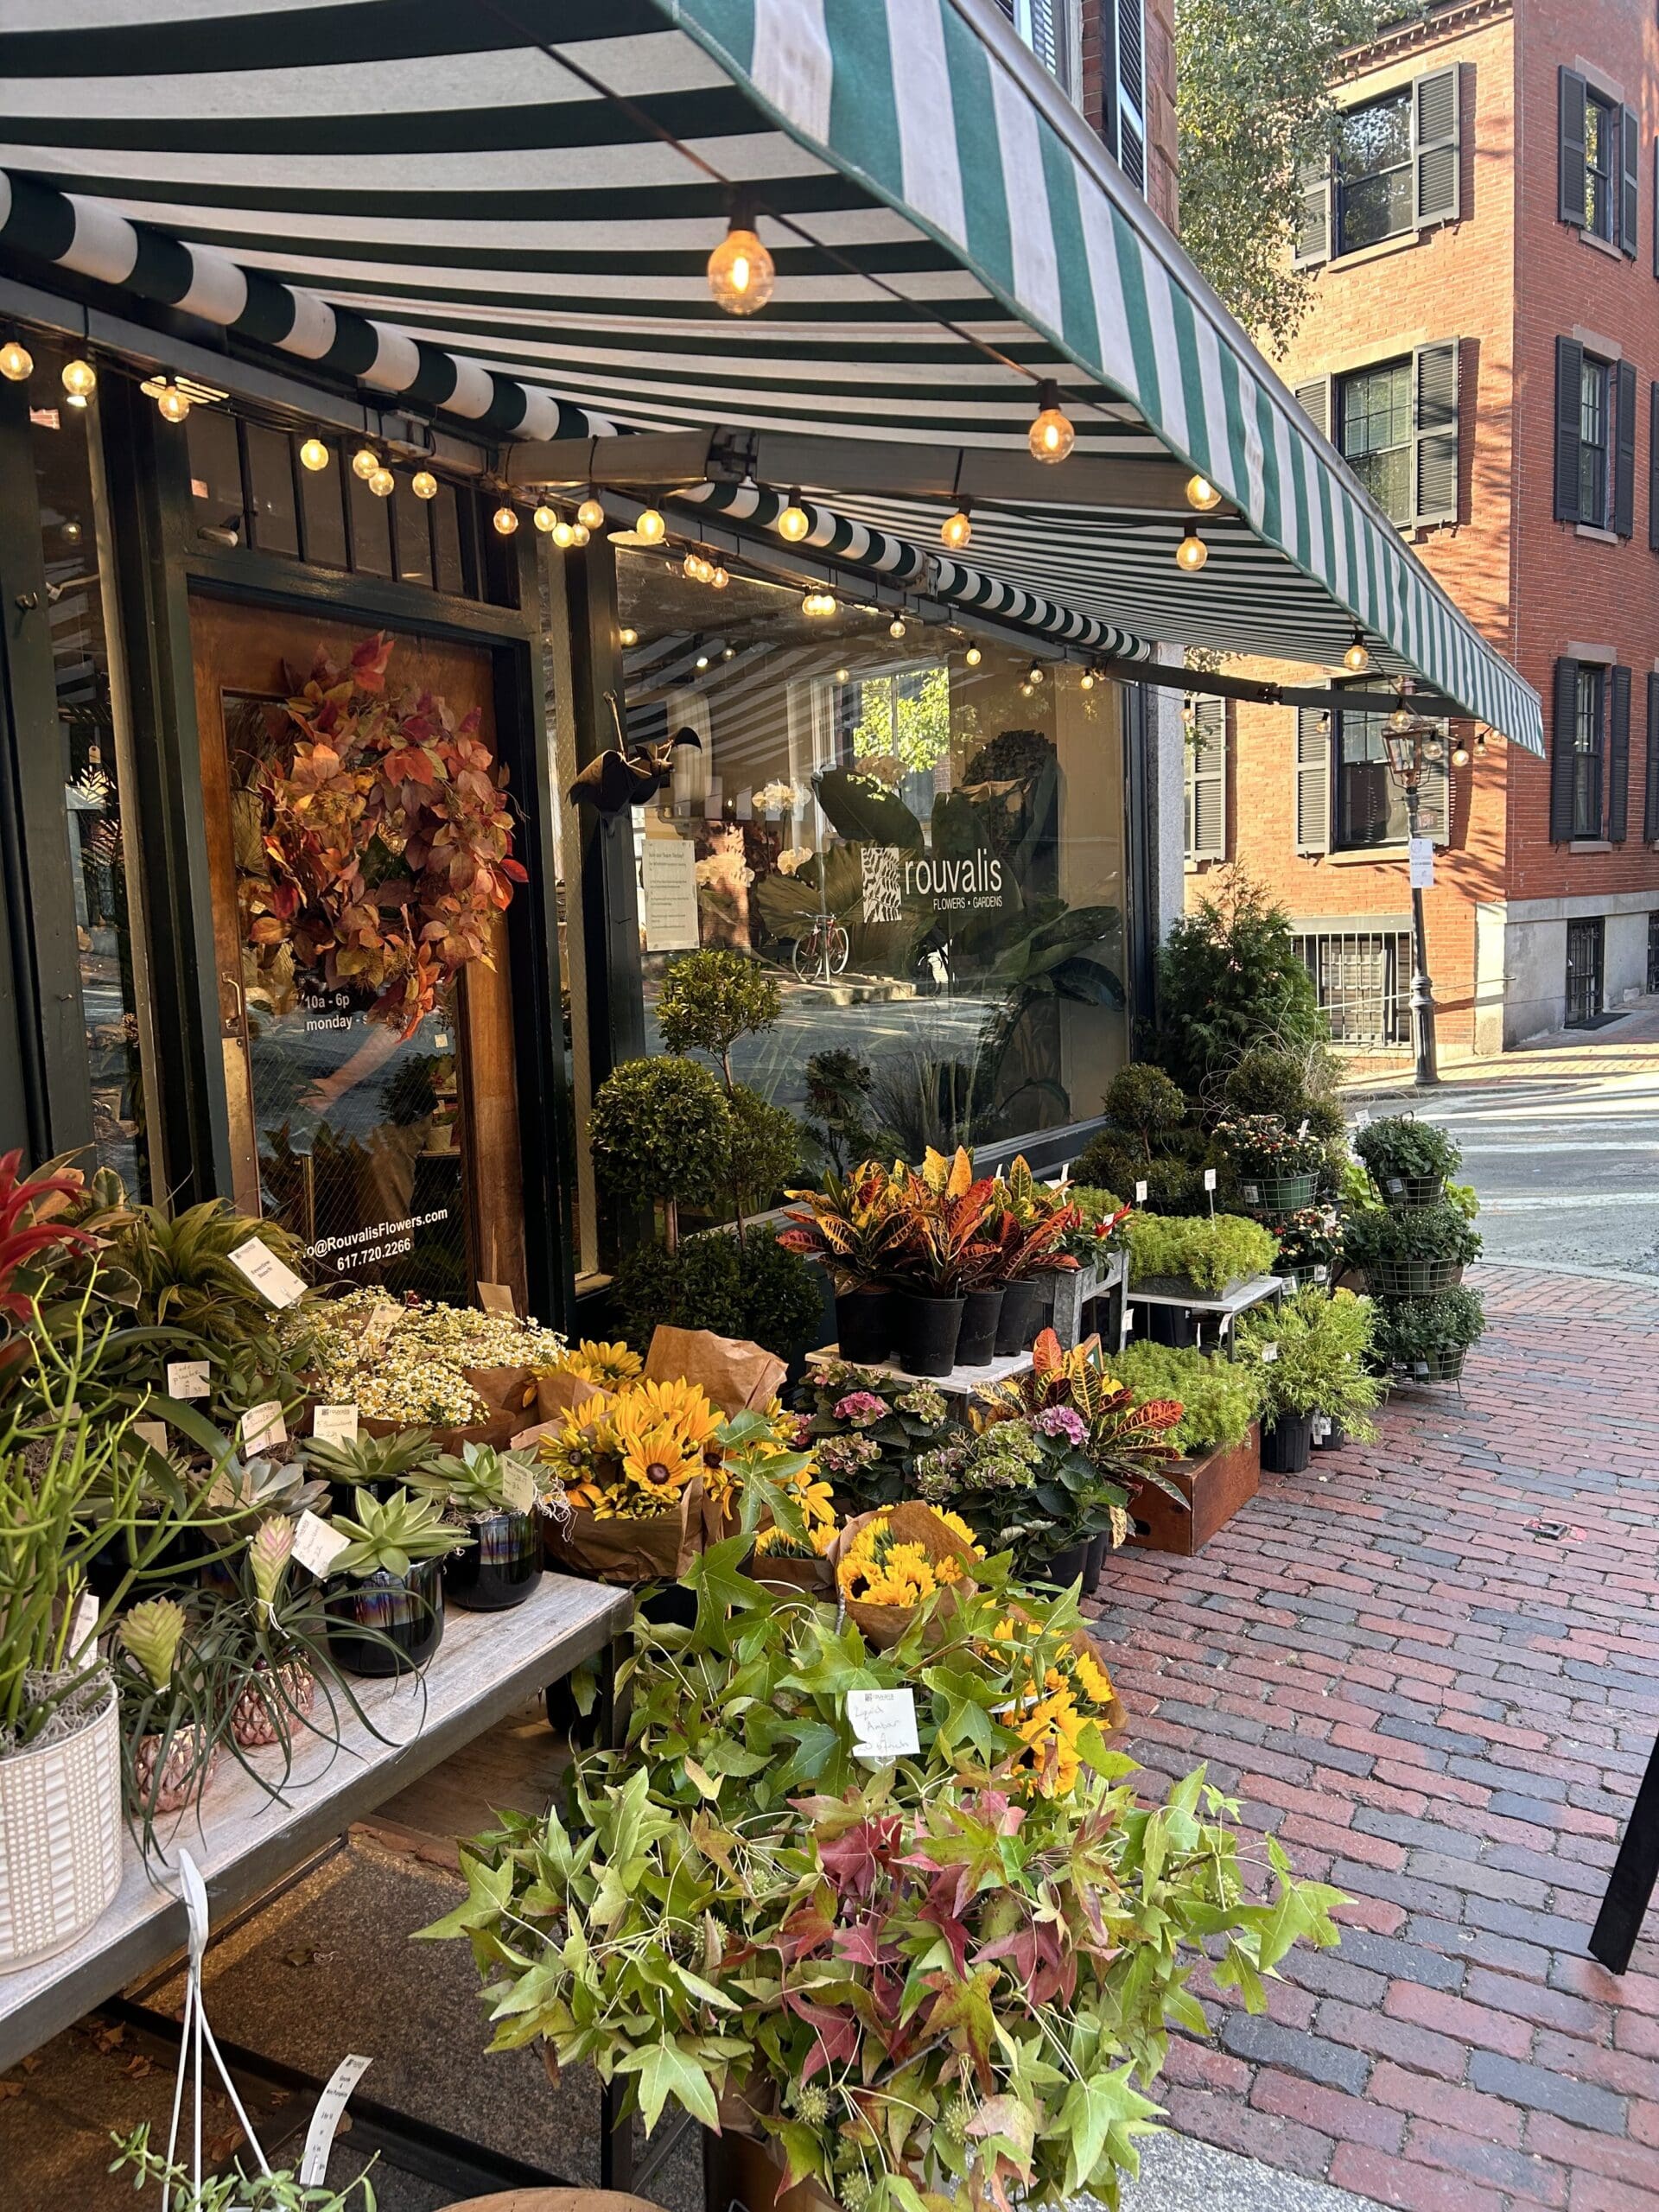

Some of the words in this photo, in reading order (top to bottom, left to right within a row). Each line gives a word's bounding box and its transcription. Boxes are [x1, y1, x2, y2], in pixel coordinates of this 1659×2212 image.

[905, 848, 1002, 895] rouvalis
[933, 897, 966, 911] FLOWERS
[972, 895, 1003, 909] GARDENS
[304, 995, 326, 1009] 10a
[335, 993, 350, 1009] 6p
[306, 1014, 353, 1032] monday
[337, 1237, 411, 1271] 617.720.2266
